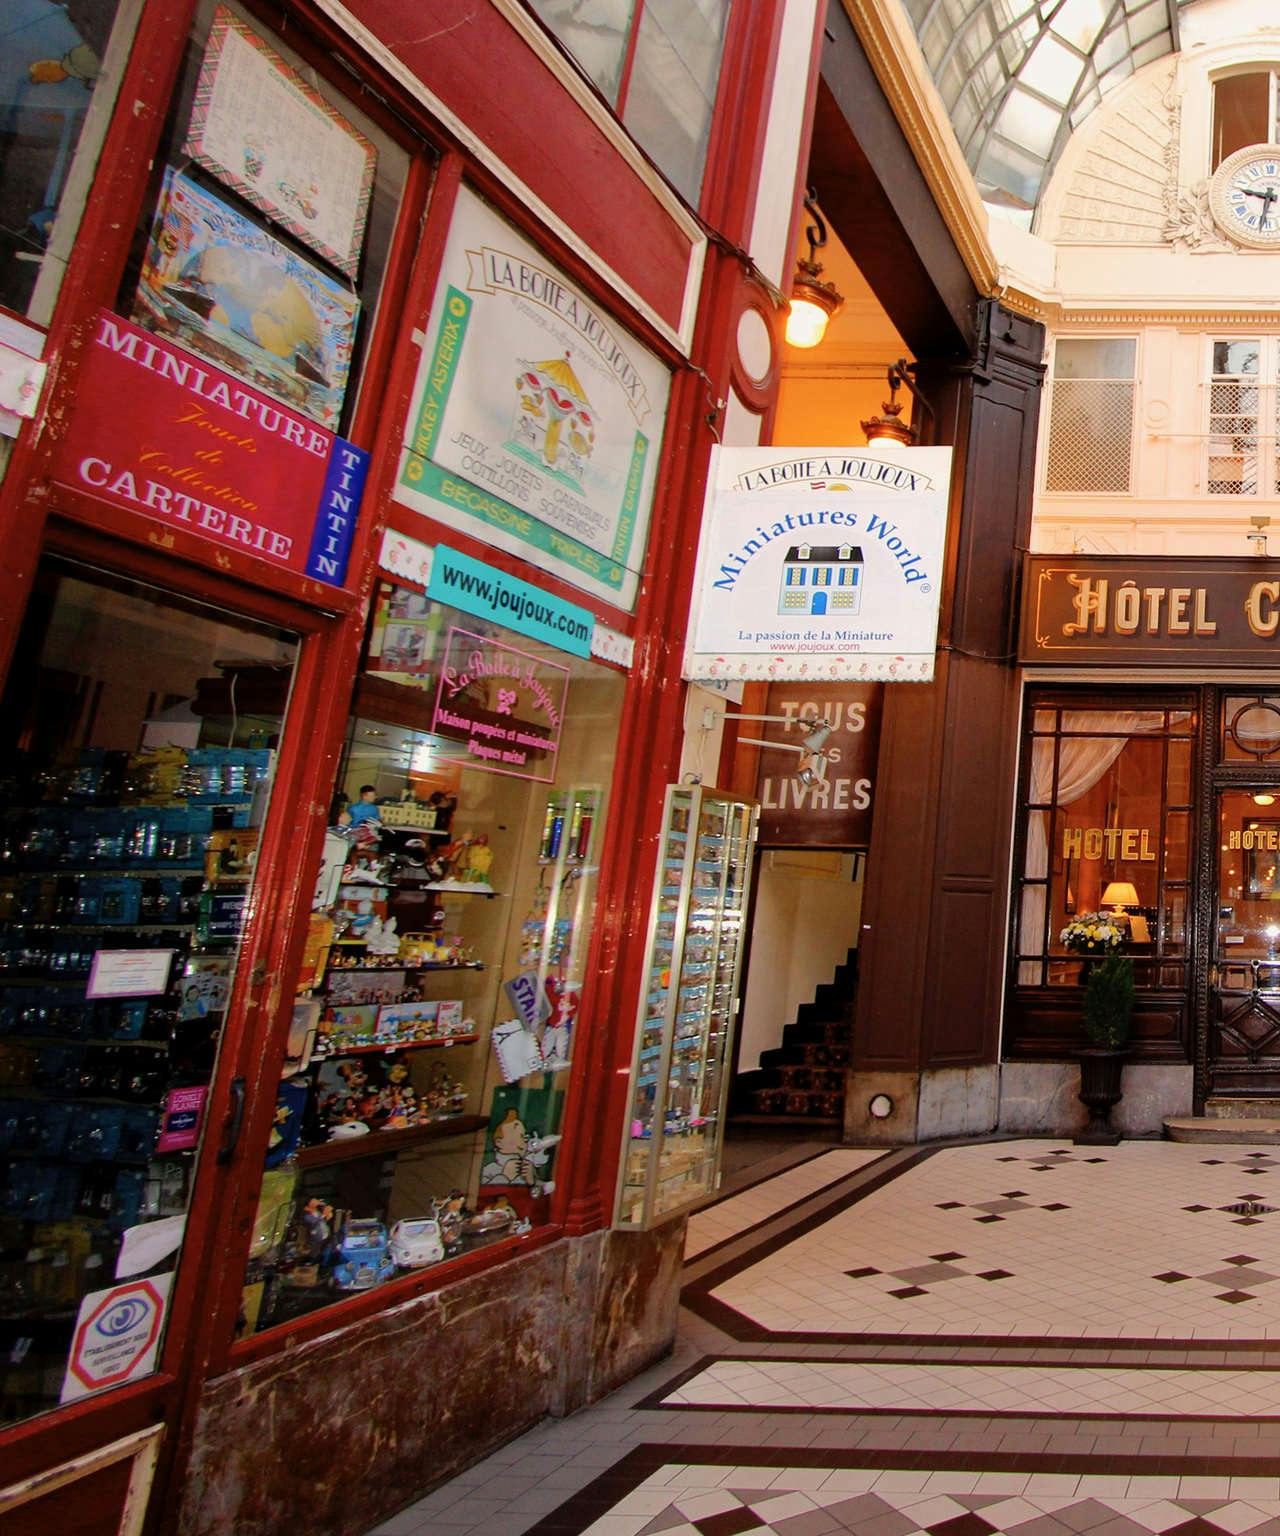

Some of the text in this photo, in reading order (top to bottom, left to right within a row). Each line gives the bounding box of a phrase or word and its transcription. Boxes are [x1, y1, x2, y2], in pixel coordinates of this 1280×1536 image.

[432, 319, 461, 393] ASTERIX
[491, 255, 515, 288] LA
[566, 298, 578, 325] A
[582, 305, 642, 398] JOUJOUX
[96, 318, 330, 458] MINIATURE
[172, 402, 258, 453] Jouets
[195, 449, 224, 465] de
[140, 444, 258, 513] Collection
[451, 431, 488, 458] JEUX
[496, 456, 544, 491] JOUETS
[744, 472, 768, 491] LA
[819, 460, 832, 476] A
[836, 459, 921, 491] JOUJOUX
[80, 457, 293, 561] CARTERIE
[315, 450, 361, 577] TINTIN
[712, 510, 927, 592] Miniatures World
[443, 563, 589, 643] www.joujoux.com
[1062, 573, 1218, 637] HÔTEL
[738, 630, 894, 644] La passion de la Miniature
[770, 642, 861, 654] www.joujoux.com
[780, 701, 866, 733] TOUS
[761, 778, 872, 811] LIVRES
[1063, 827, 1156, 862] HOTEL
